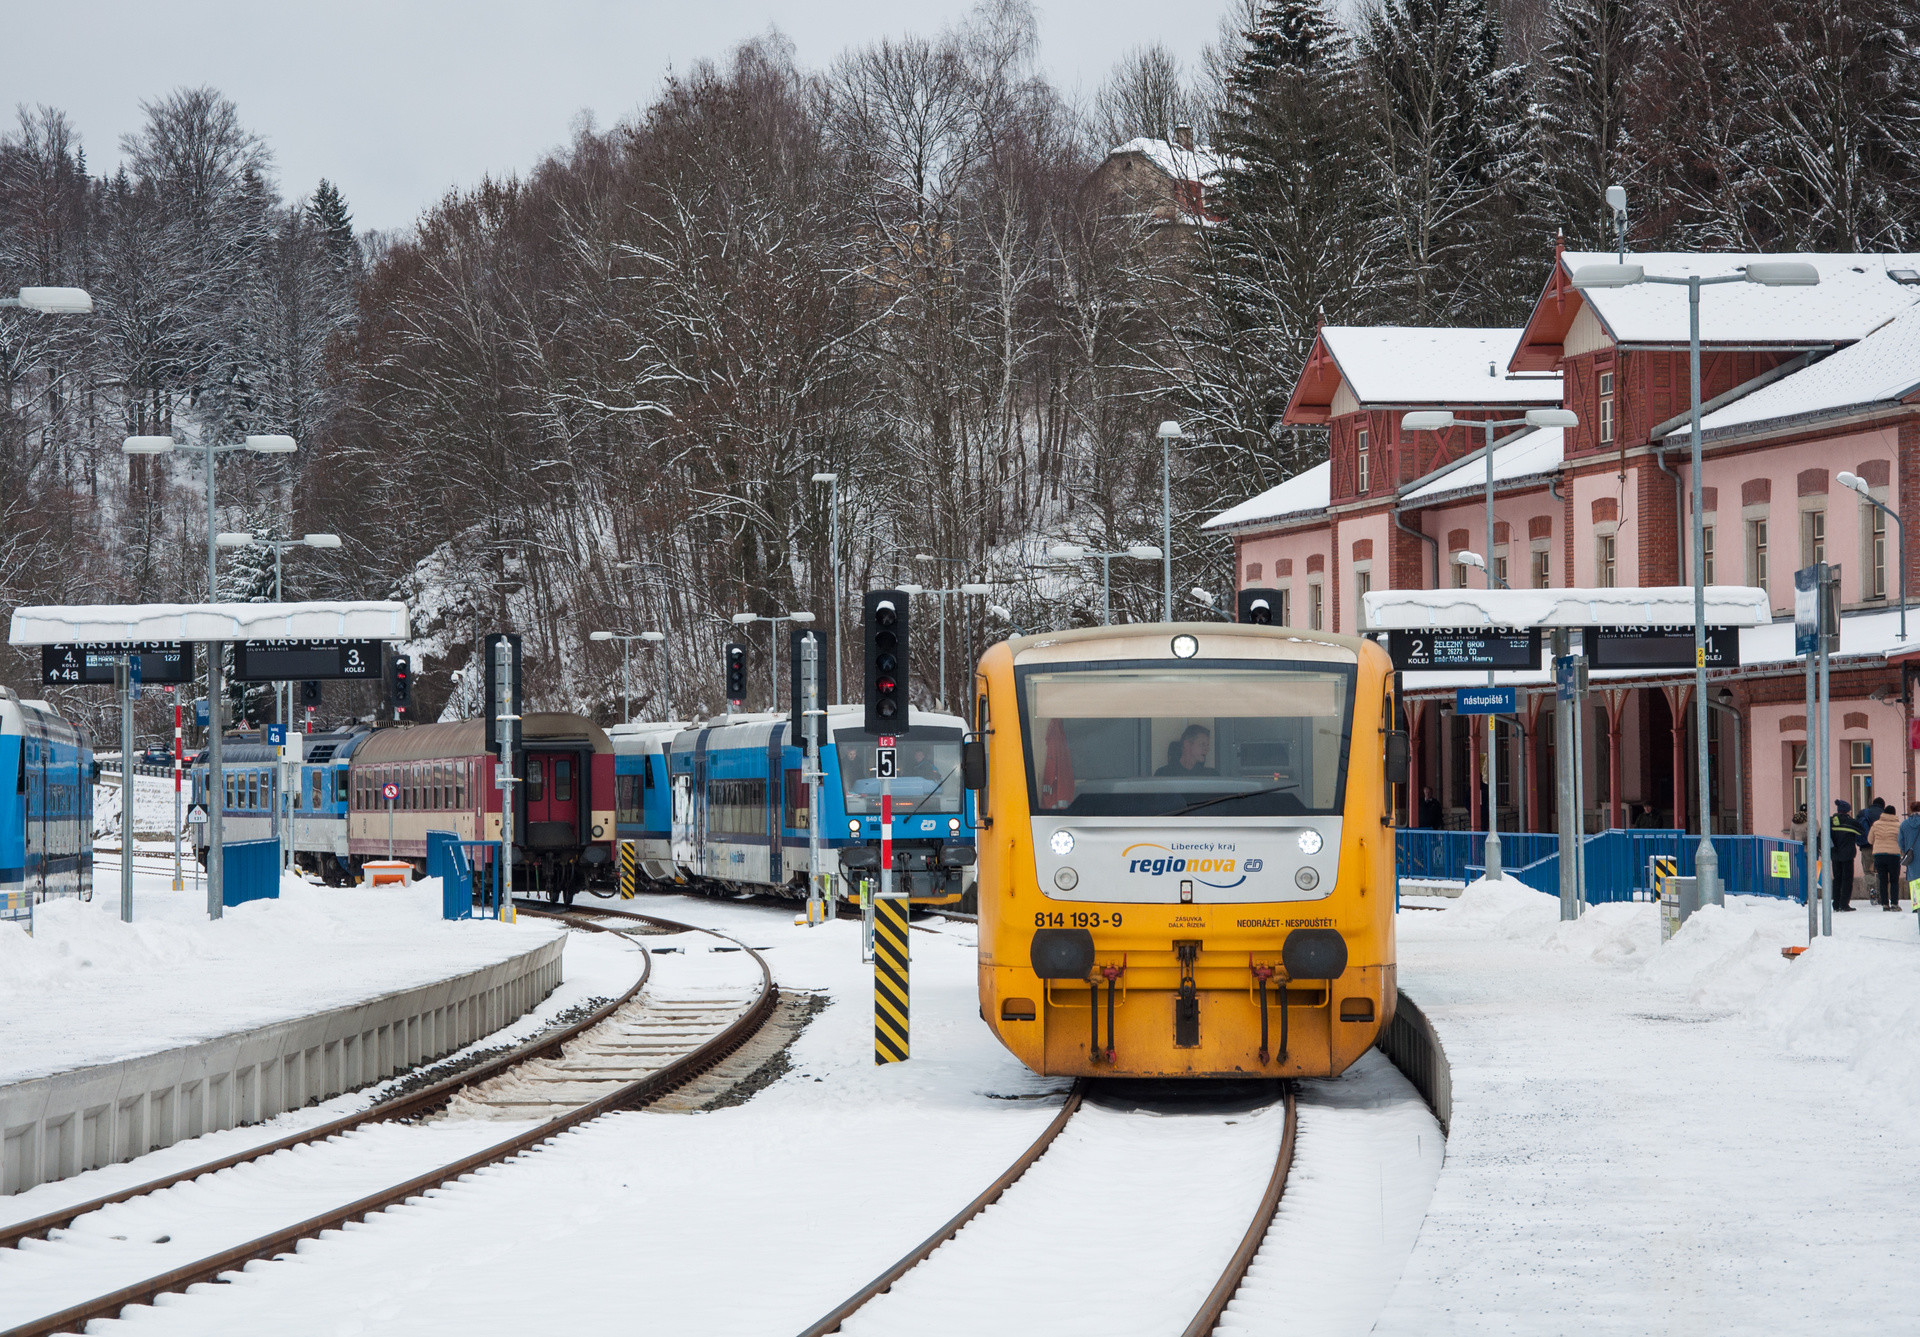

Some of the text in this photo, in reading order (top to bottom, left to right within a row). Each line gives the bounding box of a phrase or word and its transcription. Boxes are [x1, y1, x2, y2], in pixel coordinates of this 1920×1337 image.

[1411, 639, 1429, 657] 2.
[1705, 636, 1719, 653] 1.
[64, 651, 77, 663] 4.
[348, 649, 365, 666] 3.
[1472, 655, 1493, 663] Hamry
[62, 668, 79, 680] 4a
[1463, 694, 1509, 707] nástupiště 1
[270, 733, 280, 743] 4a
[880, 737, 894, 746] Lc 3
[881, 751, 892, 776] 5
[1171, 842, 1236, 852] Liberecký kraj
[1129, 856, 1236, 876] regionova
[1034, 912, 1064, 927] 814
[1236, 917, 1280, 928] NEODRÁŽET
[1285, 917, 1333, 927] NESPOUŠTĚT
